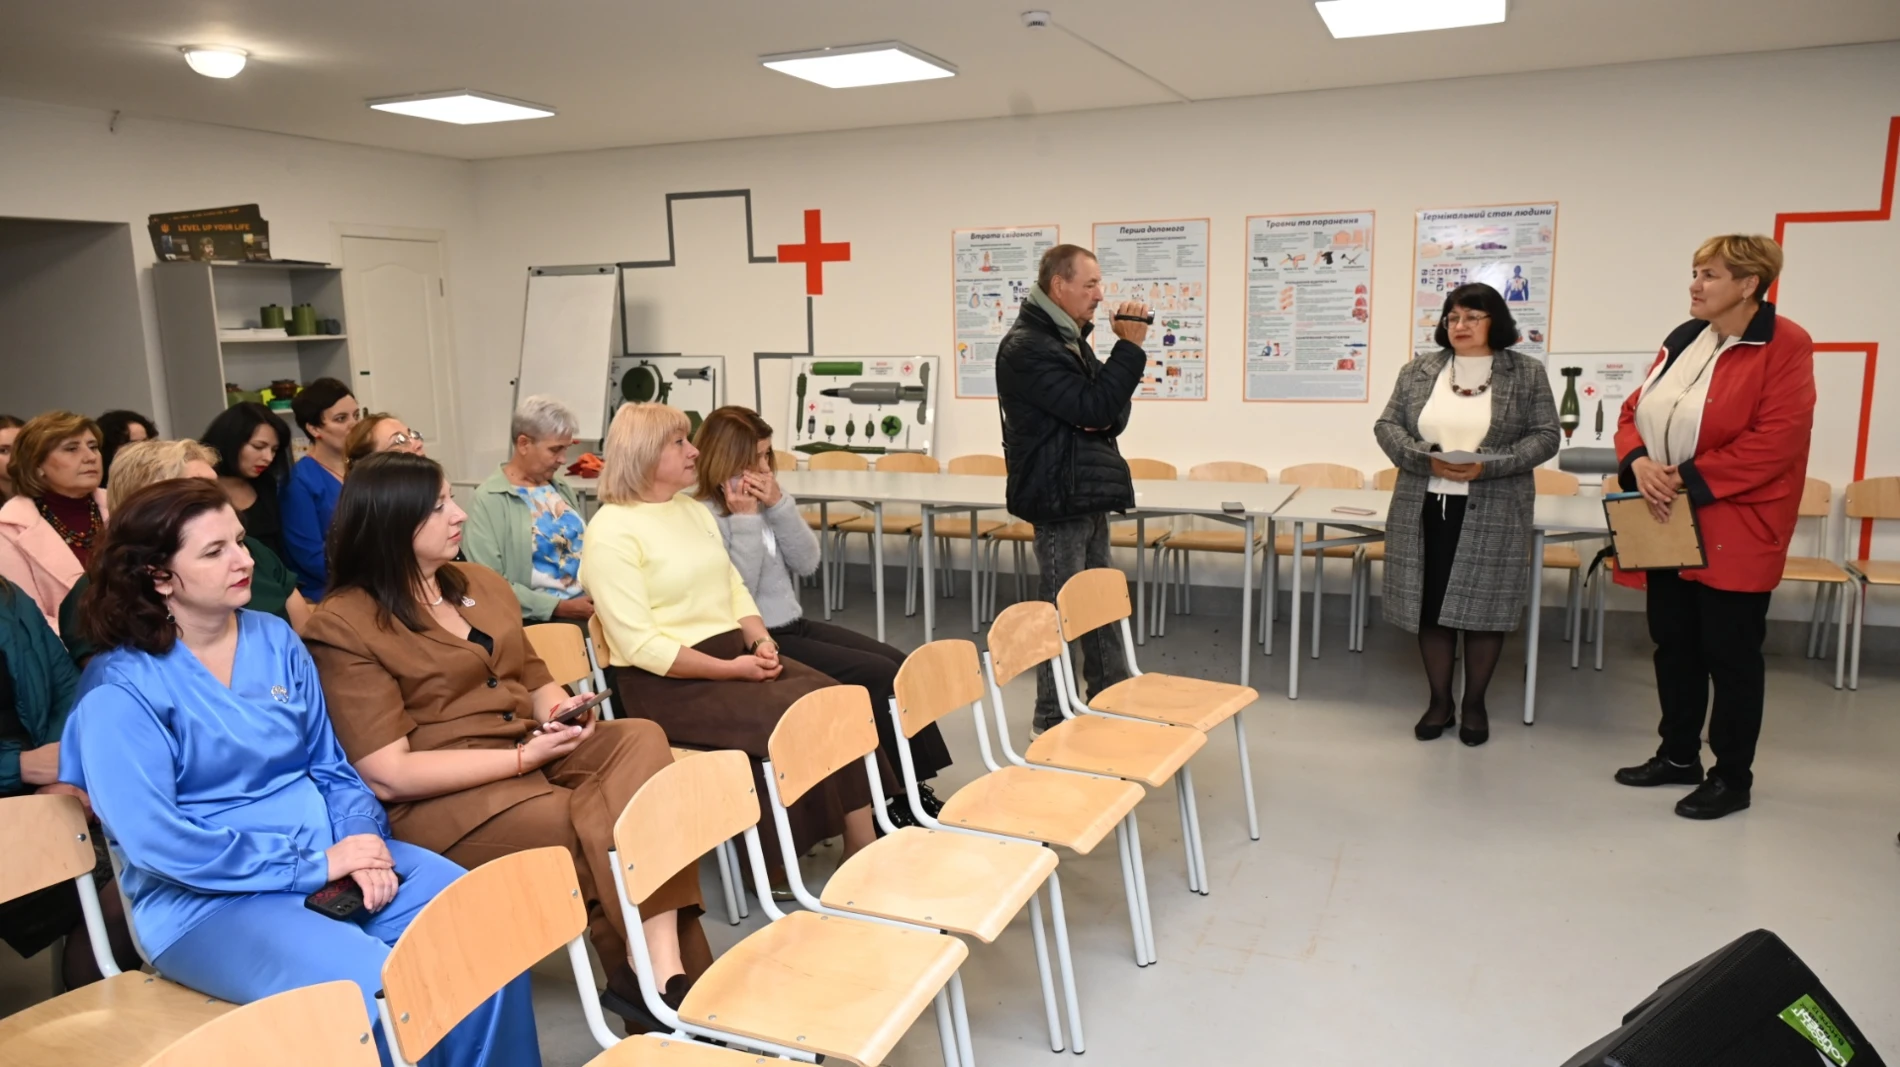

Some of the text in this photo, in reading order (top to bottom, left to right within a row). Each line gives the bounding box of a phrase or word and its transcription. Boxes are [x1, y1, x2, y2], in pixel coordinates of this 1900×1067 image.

[1423, 211, 1485, 222] Термінальний
[1514, 208, 1552, 217] людини
[178, 223, 250, 232] LEVEL UP YOUR LIFE
[1266, 220, 1296, 229] Травми
[1312, 218, 1359, 227] поранення
[1119, 225, 1185, 235] Перша допомога
[970, 230, 1043, 241] Втрата свідомості
[1595, 432, 1602, 441] 2
